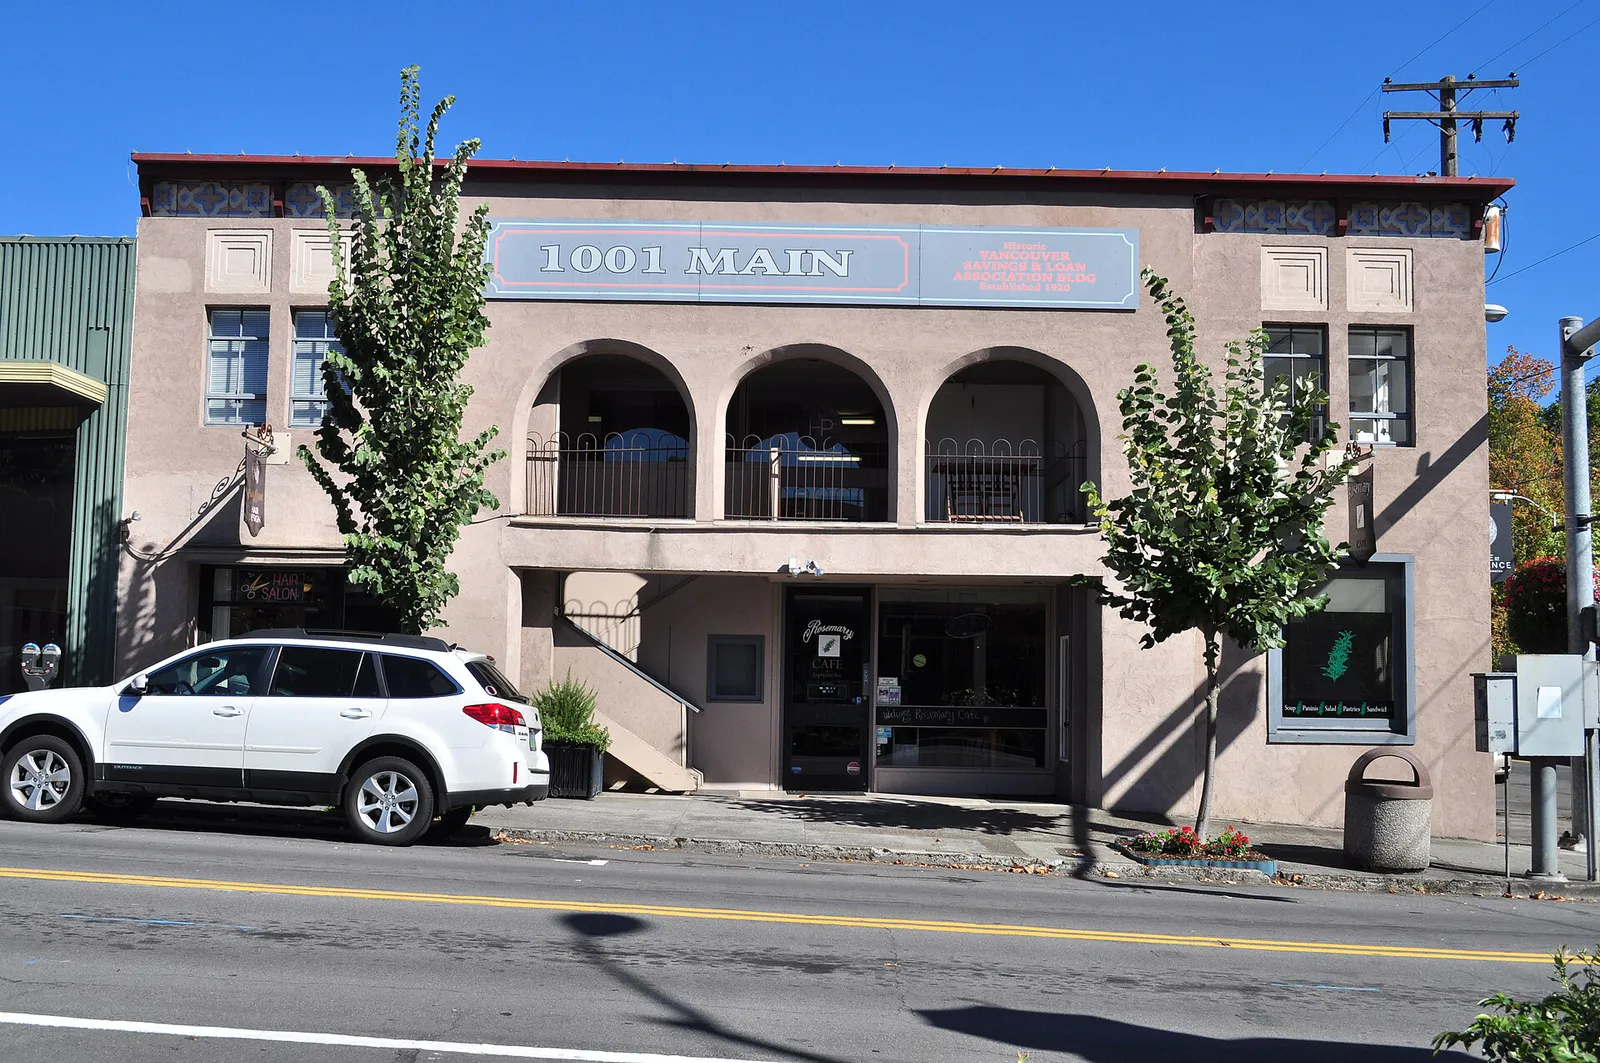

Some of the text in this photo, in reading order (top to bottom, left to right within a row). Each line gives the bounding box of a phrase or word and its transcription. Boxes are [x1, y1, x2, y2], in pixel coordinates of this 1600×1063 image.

[1003, 242, 1047, 250] Historic
[539, 244, 854, 277] 1001 MAIN
[979, 251, 1070, 261] VANCOUVER
[963, 261, 1086, 272] SAVINGS & LOAN
[953, 271, 1097, 283] ASSOCIATION BLDG
[979, 283, 1041, 291] Established
[273, 573, 298, 586] HAIR
[261, 587, 298, 600] SALON
[803, 619, 854, 643] Rosemary
[812, 659, 844, 669] CAFE
[1284, 704, 1297, 712] Soup
[915, 708, 955, 725] Rosemary
